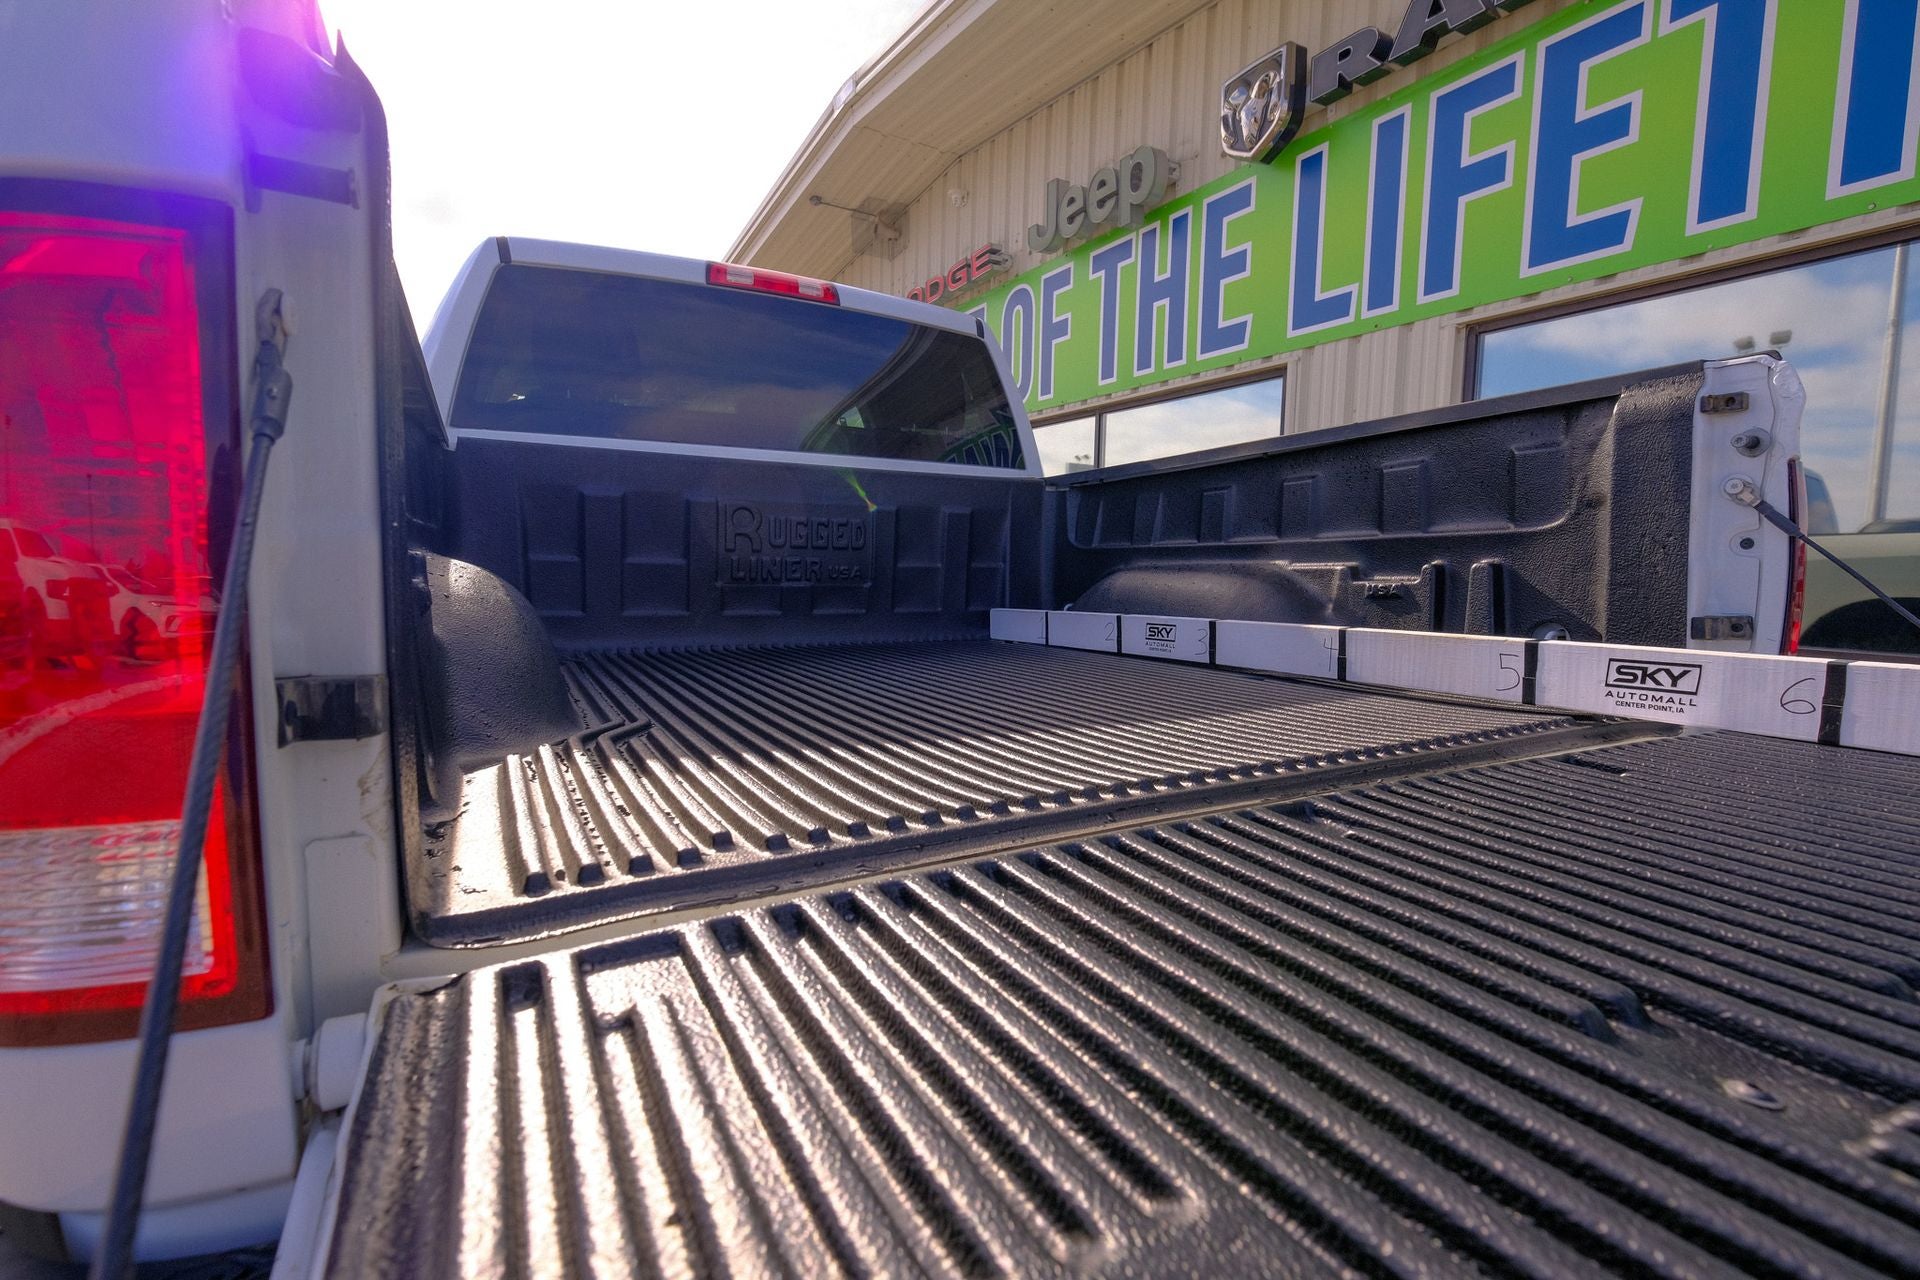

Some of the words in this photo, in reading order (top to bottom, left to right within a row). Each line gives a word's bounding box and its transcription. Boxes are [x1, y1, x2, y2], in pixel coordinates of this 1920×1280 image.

[1310, 0, 1512, 101] RA
[1028, 145, 1157, 252] Jeep
[1000, 262, 1074, 403] OF
[1089, 176, 1257, 388] THE
[724, 506, 867, 553] RUGGED
[730, 555, 822, 582] LINER
[827, 563, 864, 580] USA
[1104, 621, 1116, 642] 2
[1145, 641, 1175, 649] AUTOMALL
[1149, 627, 1173, 638] SKY
[1194, 628, 1208, 656] 3
[1322, 636, 1338, 672] 4
[1496, 652, 1520, 692] 5
[1613, 665, 1692, 687] SKY
[1605, 690, 1696, 706] AUTOMALL
[1615, 700, 1646, 710] CENTER
[1647, 704, 1674, 714] POINT,
[1780, 677, 1816, 715] 6
